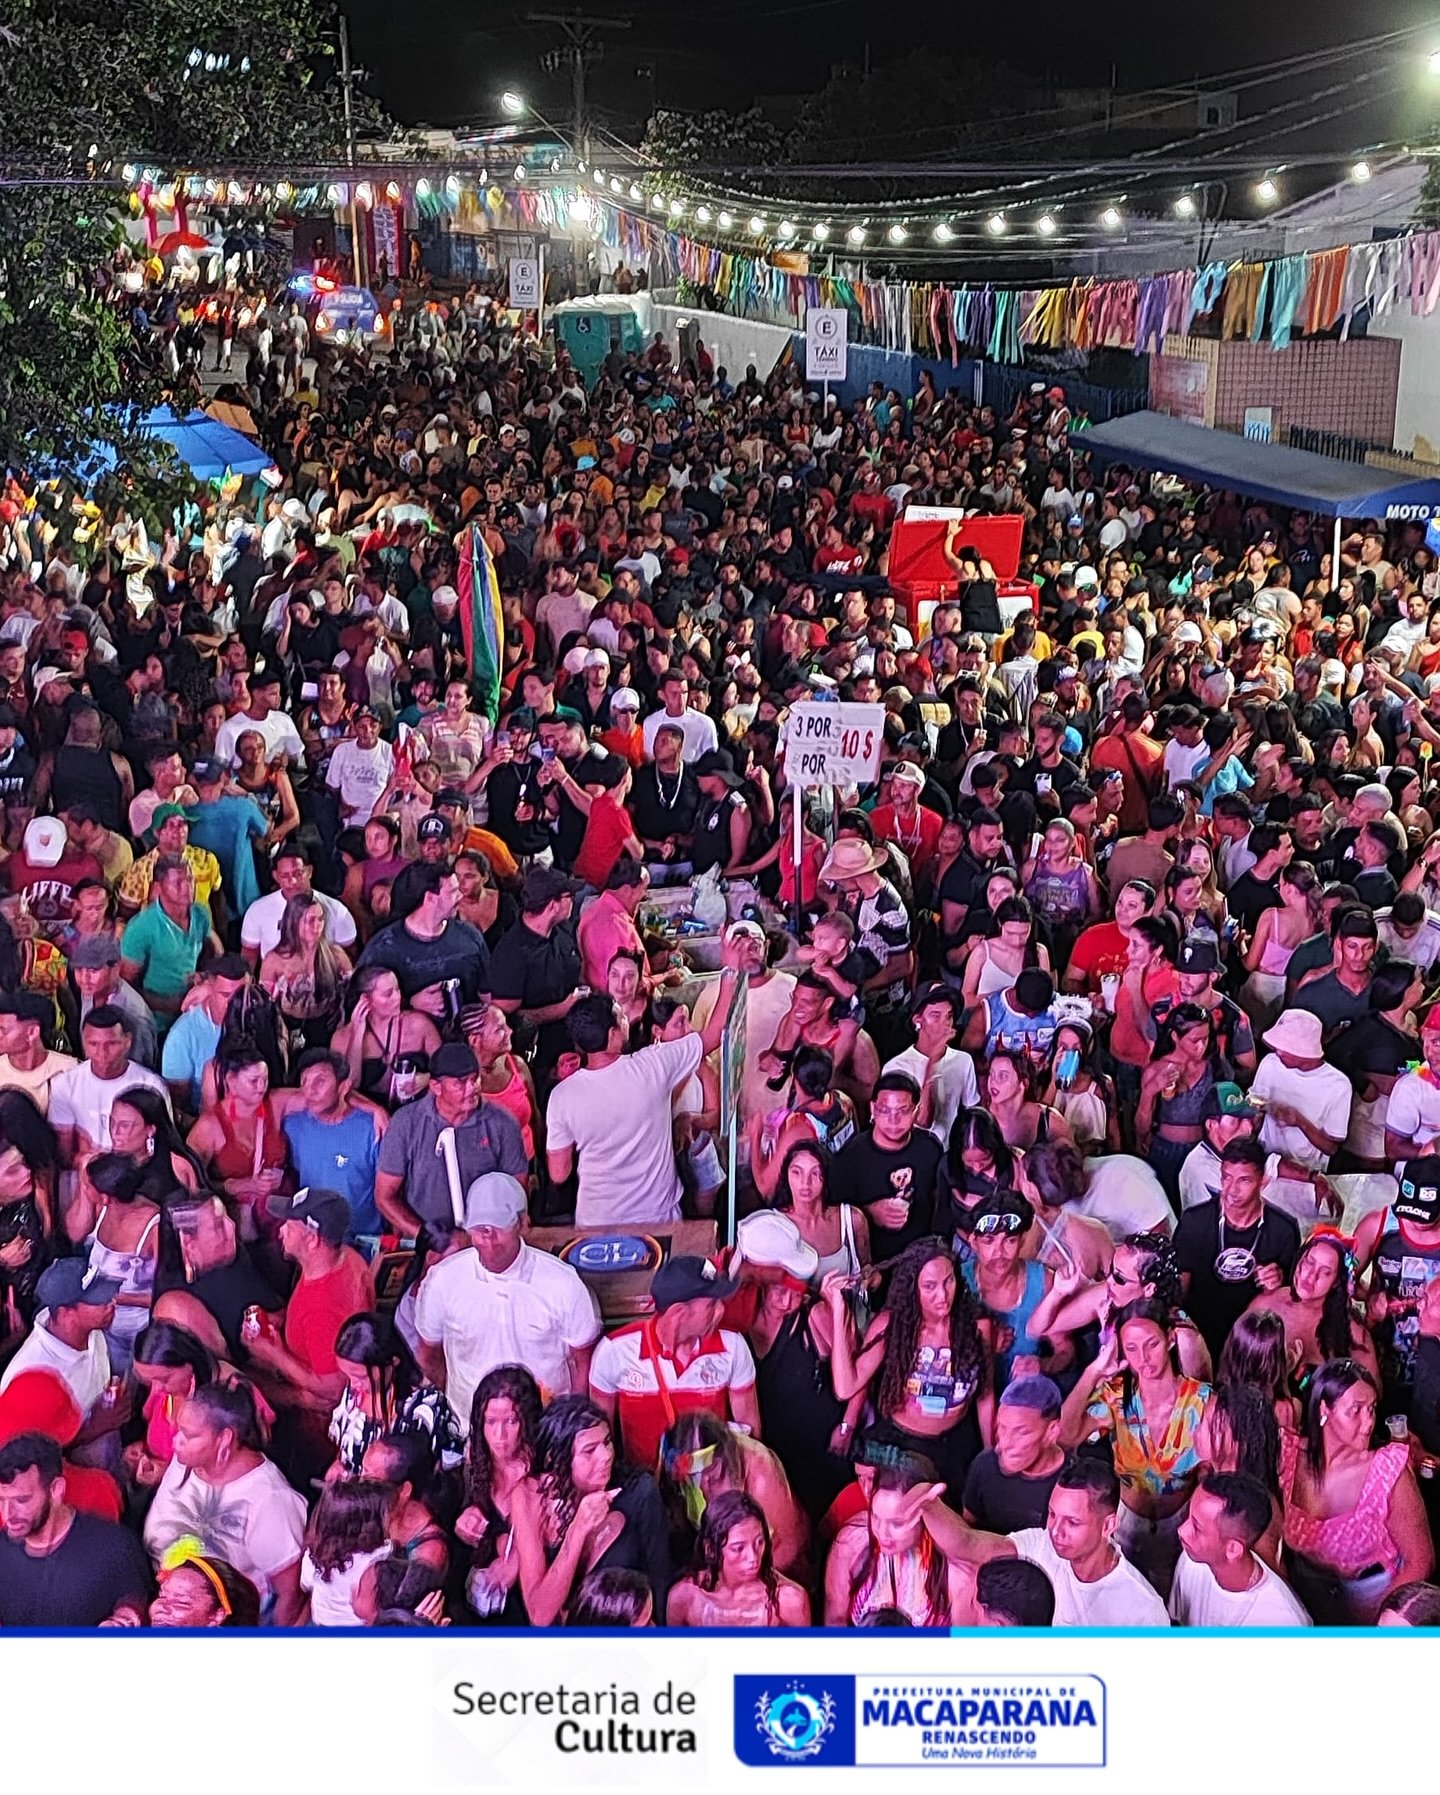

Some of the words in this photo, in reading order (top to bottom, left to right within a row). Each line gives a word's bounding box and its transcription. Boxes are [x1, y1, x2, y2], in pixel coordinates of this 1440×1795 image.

[521, 267, 528, 276] E
[823, 321, 832, 335] E
[1386, 504, 1430, 520] MOTO
[795, 715, 804, 738] 3
[805, 716, 832, 738] POR
[841, 728, 860, 760] 10
[801, 753, 827, 775] POR
[579, 1241, 638, 1264] CL
